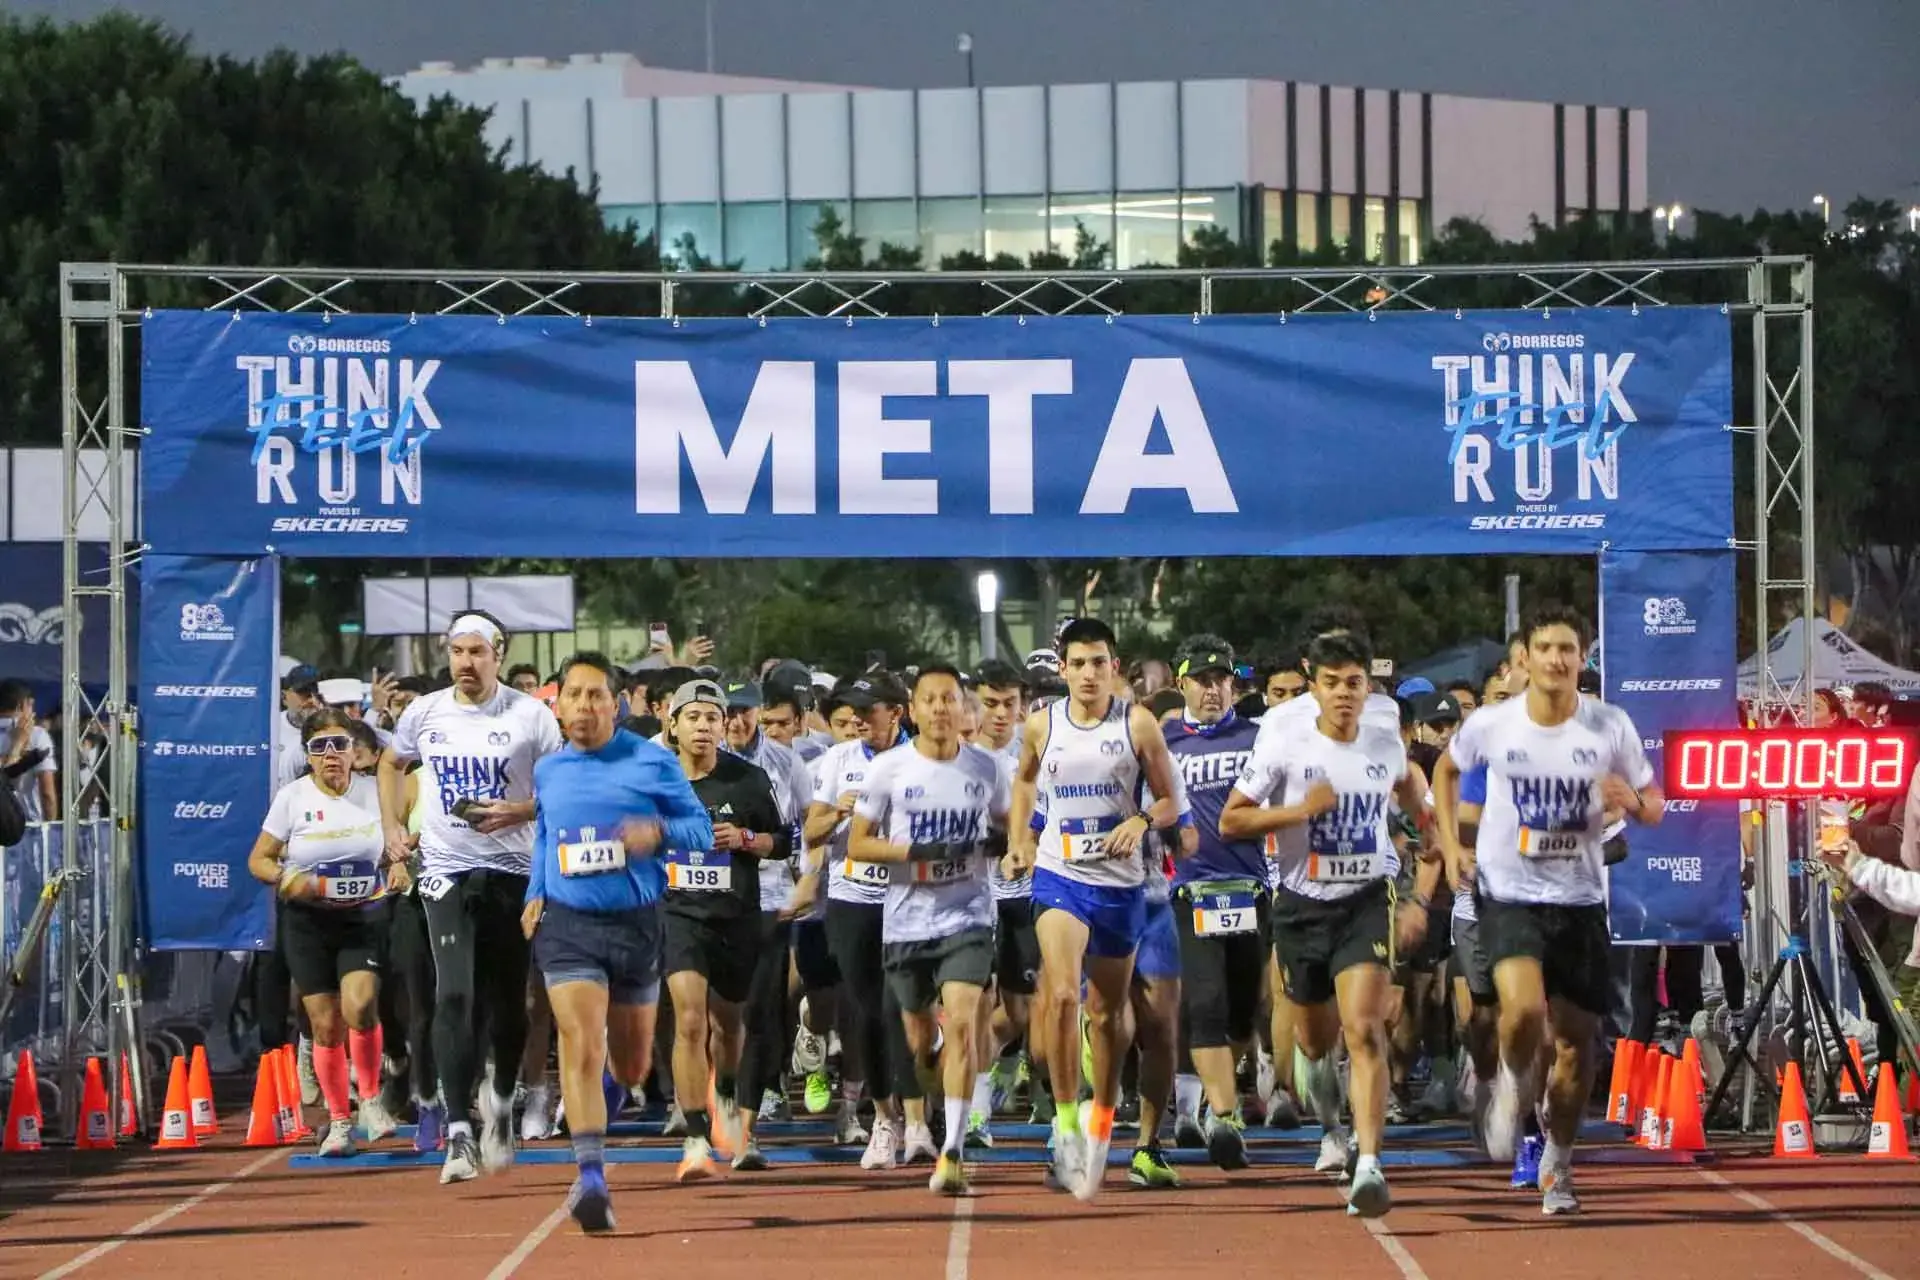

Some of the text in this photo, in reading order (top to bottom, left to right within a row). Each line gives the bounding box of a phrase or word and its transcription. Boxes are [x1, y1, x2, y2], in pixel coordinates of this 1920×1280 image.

[318, 338, 391, 353] BORREGOS
[1512, 335, 1585, 349] BORREGOS
[236, 355, 442, 429] THINK
[1431, 352, 1638, 425] THINK
[246, 392, 431, 466] FEEL
[1442, 390, 1629, 465] FEEL
[635, 357, 1240, 515] META
[256, 435, 422, 505] RUN
[1454, 431, 1618, 502] RUN
[1516, 504, 1557, 513] POWERED BY
[271, 518, 408, 533] SKECHERS
[1469, 514, 1606, 530] SKECHERS
[154, 685, 257, 697] SKECHERS
[1619, 678, 1722, 692] SKECHERS
[176, 743, 257, 756] BANORTE
[429, 755, 511, 786] THINK
[1193, 779, 1229, 792] RUNNING
[1506, 775, 1595, 807] THINK
[174, 800, 233, 819] telcel
[579, 847, 615, 864] 421
[174, 863, 229, 878] POWER
[864, 864, 889, 880] 40
[1328, 859, 1371, 877] 1142
[1647, 857, 1701, 871] POWER
[198, 876, 229, 888] ADE
[686, 869, 718, 885] 198
[1672, 868, 1701, 882] ADE
[336, 880, 369, 896] 587
[1220, 913, 1242, 928] 57
